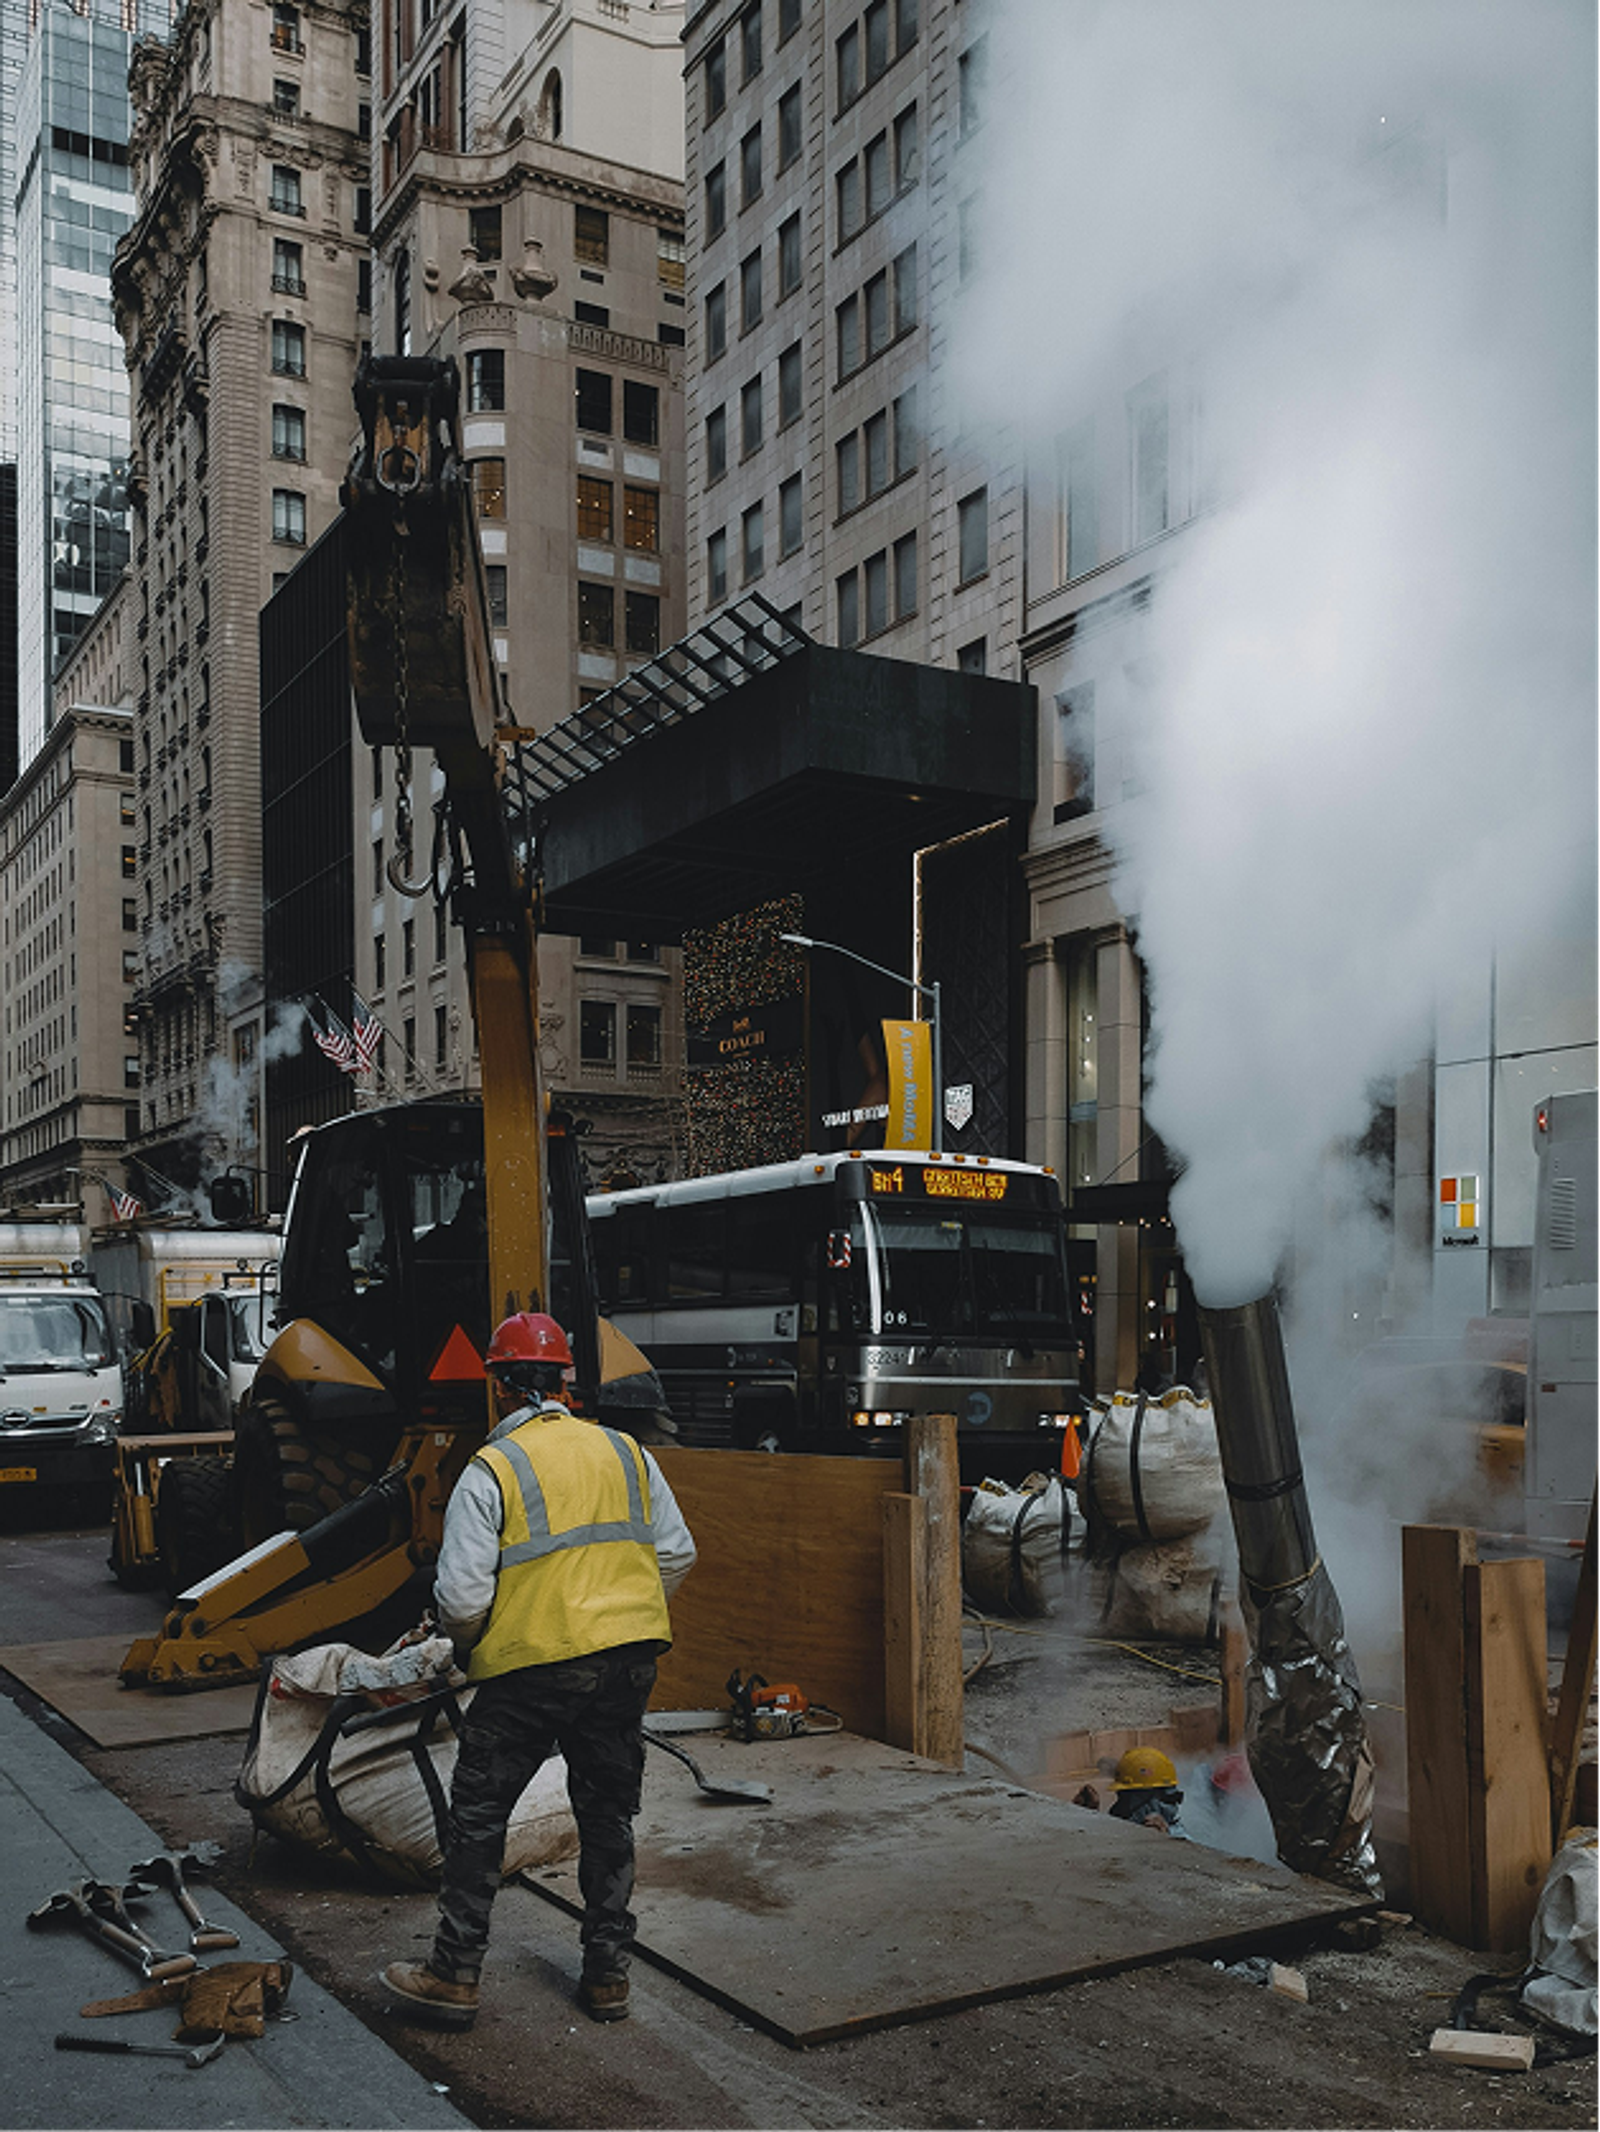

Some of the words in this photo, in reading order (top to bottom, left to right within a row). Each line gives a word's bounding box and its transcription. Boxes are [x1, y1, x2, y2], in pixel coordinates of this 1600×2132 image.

[718, 1030, 765, 1053] COACH
[899, 1025, 914, 1039] A
[901, 1042, 914, 1079] new
[902, 1082, 917, 1143] MoMA
